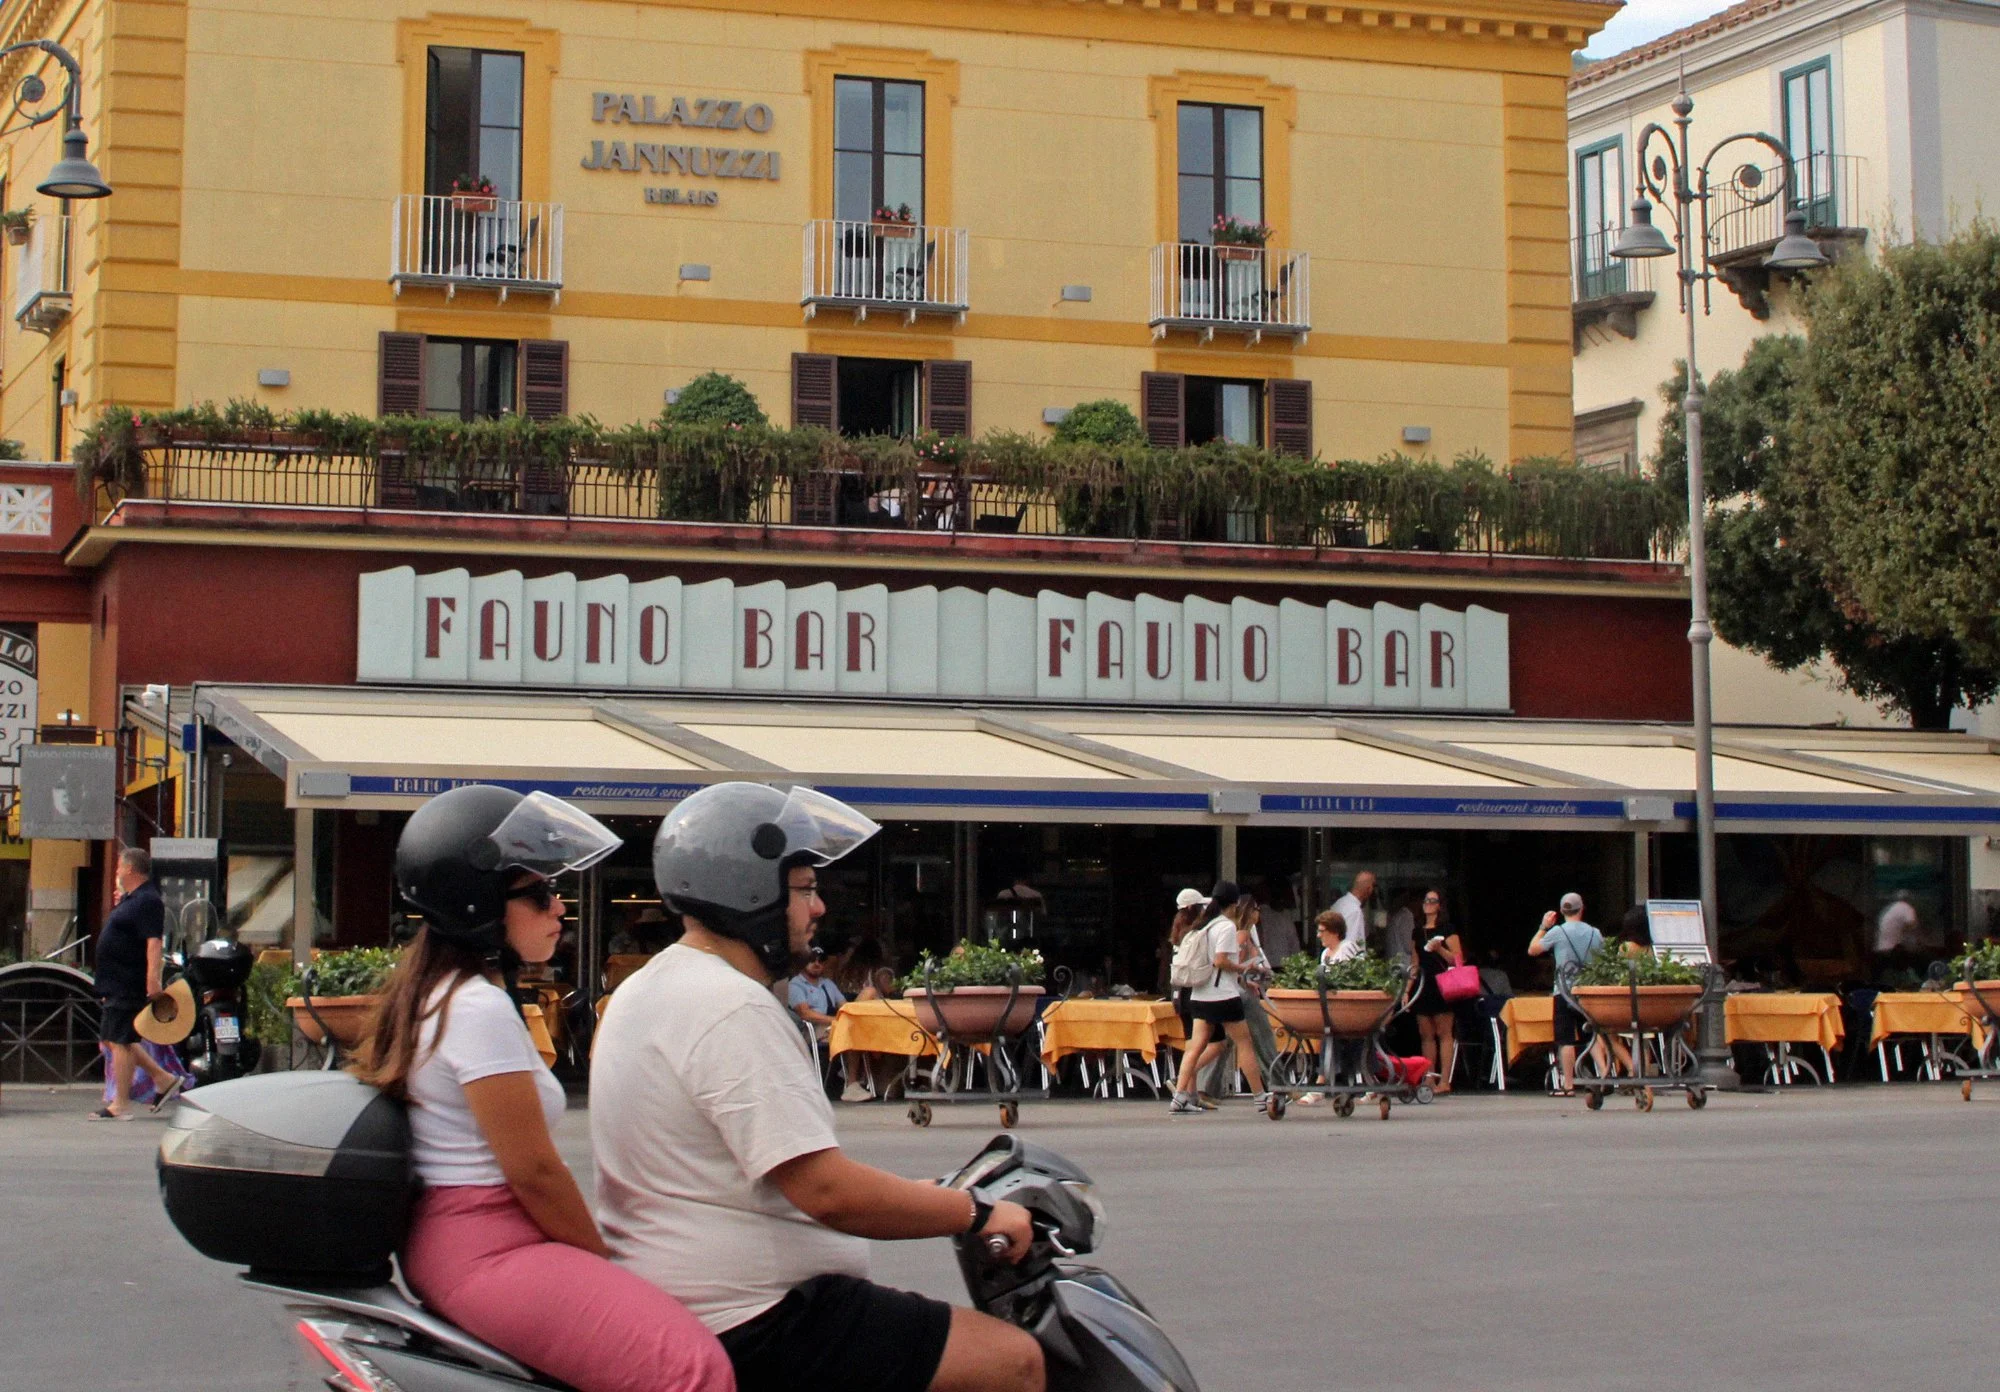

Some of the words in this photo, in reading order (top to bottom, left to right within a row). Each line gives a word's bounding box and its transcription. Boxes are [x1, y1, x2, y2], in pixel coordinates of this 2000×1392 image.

[591, 91, 774, 133] PALAZZO
[580, 140, 781, 181] JANNUZZI
[643, 187, 719, 207] RELAIS
[425, 597, 669, 665] FAUNO
[743, 608, 876, 672] BAR
[1048, 618, 1268, 683] FAUNO
[1336, 627, 1455, 689] BAR
[394, 778, 443, 793] FAUNO
[571, 785, 658, 798] restaurant
[1456, 801, 1529, 814] restaurant
